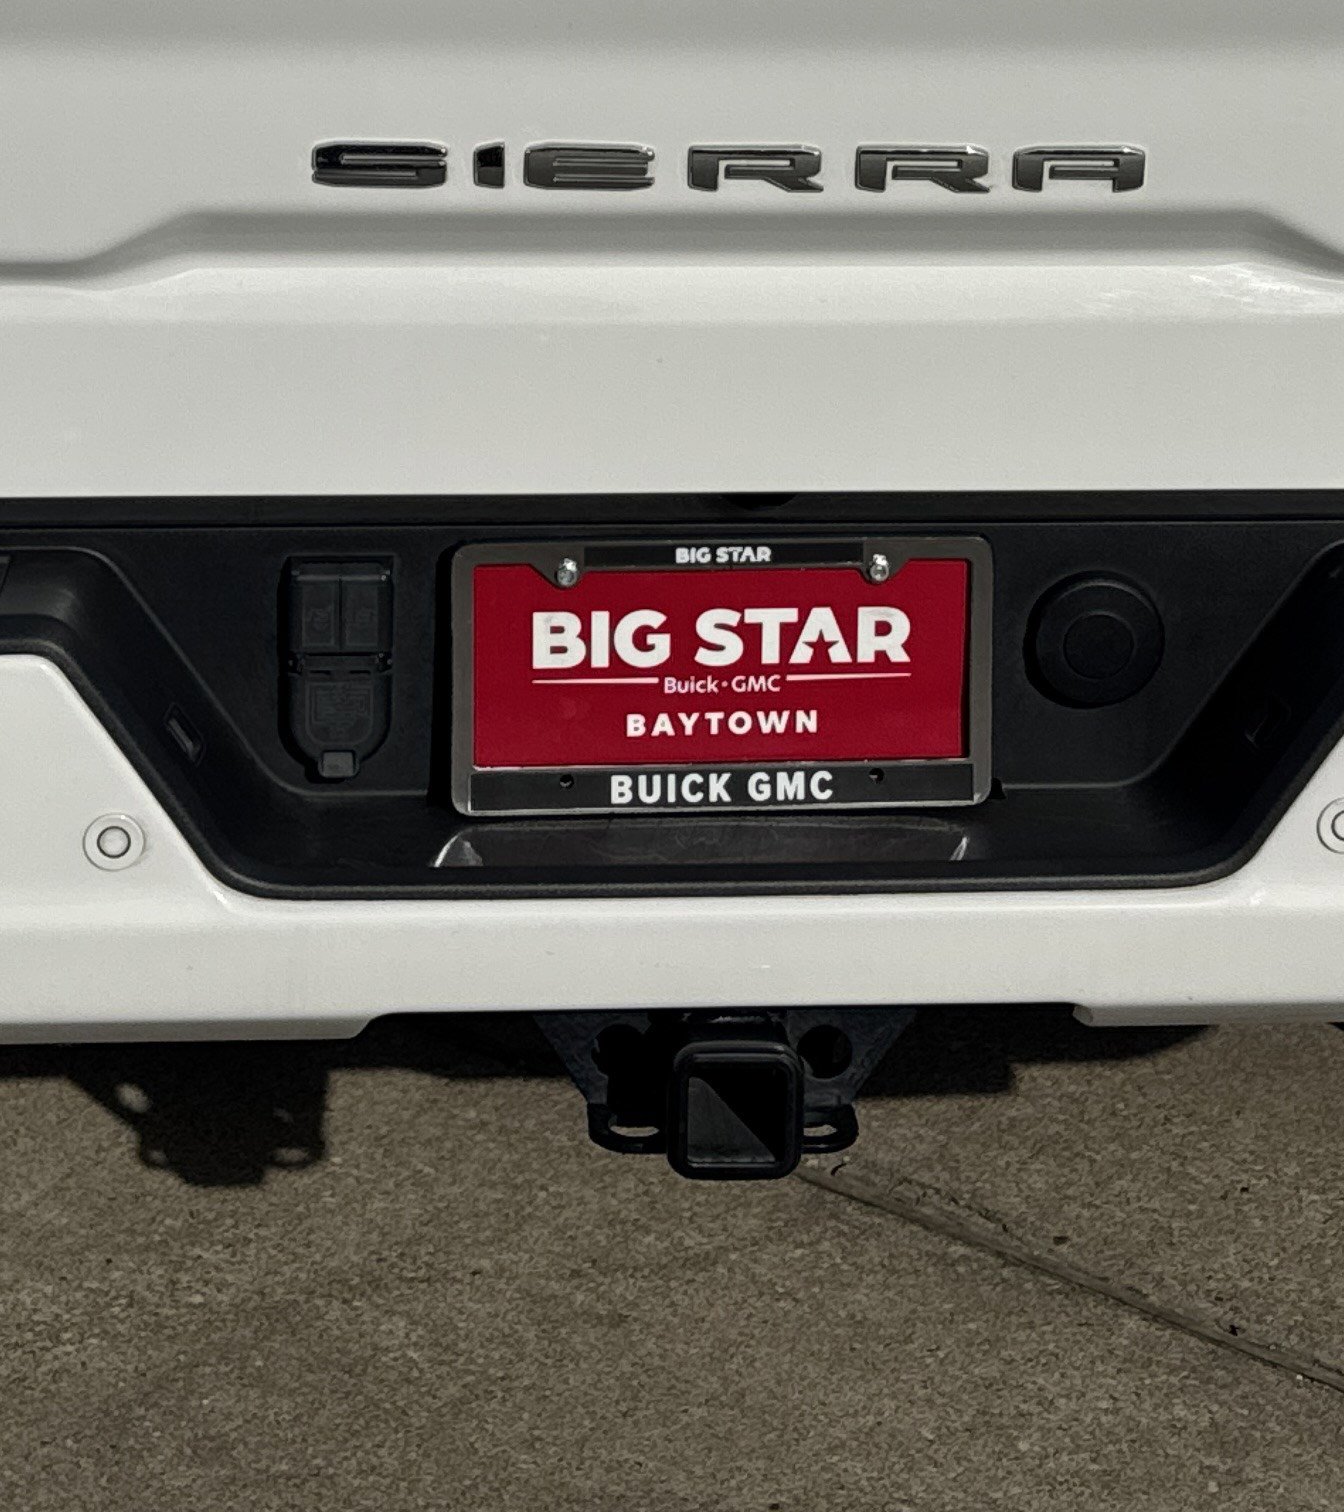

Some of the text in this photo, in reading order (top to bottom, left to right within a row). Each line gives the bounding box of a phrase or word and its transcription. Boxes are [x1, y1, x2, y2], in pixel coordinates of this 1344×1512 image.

[311, 141, 1147, 194] SIERRA
[675, 545, 772, 564] BIG STAR
[531, 606, 912, 670] BIG STAR
[663, 674, 781, 695] Buick GMC
[625, 709, 818, 738] BAYTOWN
[609, 770, 834, 805] BUICK GMC
